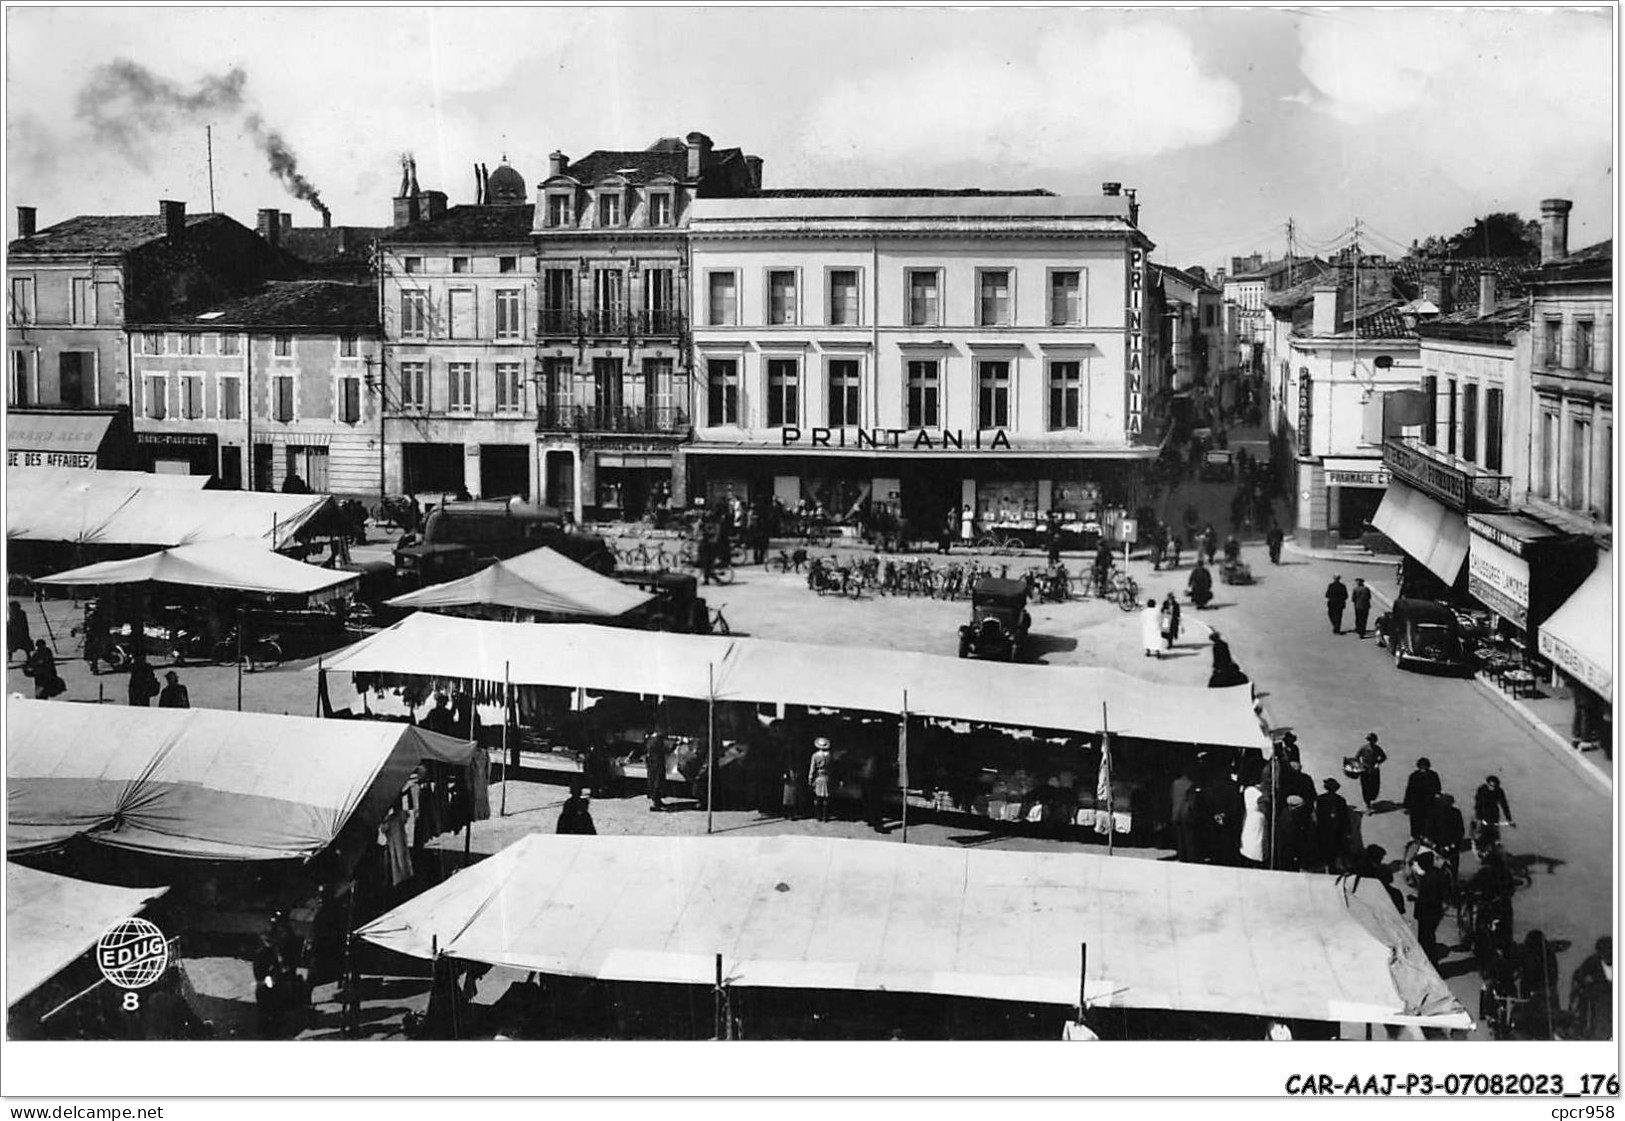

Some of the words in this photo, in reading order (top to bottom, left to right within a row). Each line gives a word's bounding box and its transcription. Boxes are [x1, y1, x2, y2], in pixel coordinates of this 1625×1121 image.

[1129, 251, 1142, 432] PRINTANIA
[781, 427, 1011, 450] PRINTANIA
[25, 453, 42, 466] DES
[47, 454, 89, 468] AFFAIRES
[1329, 472, 1374, 484] PHARMACIE
[1122, 521, 1132, 539] P
